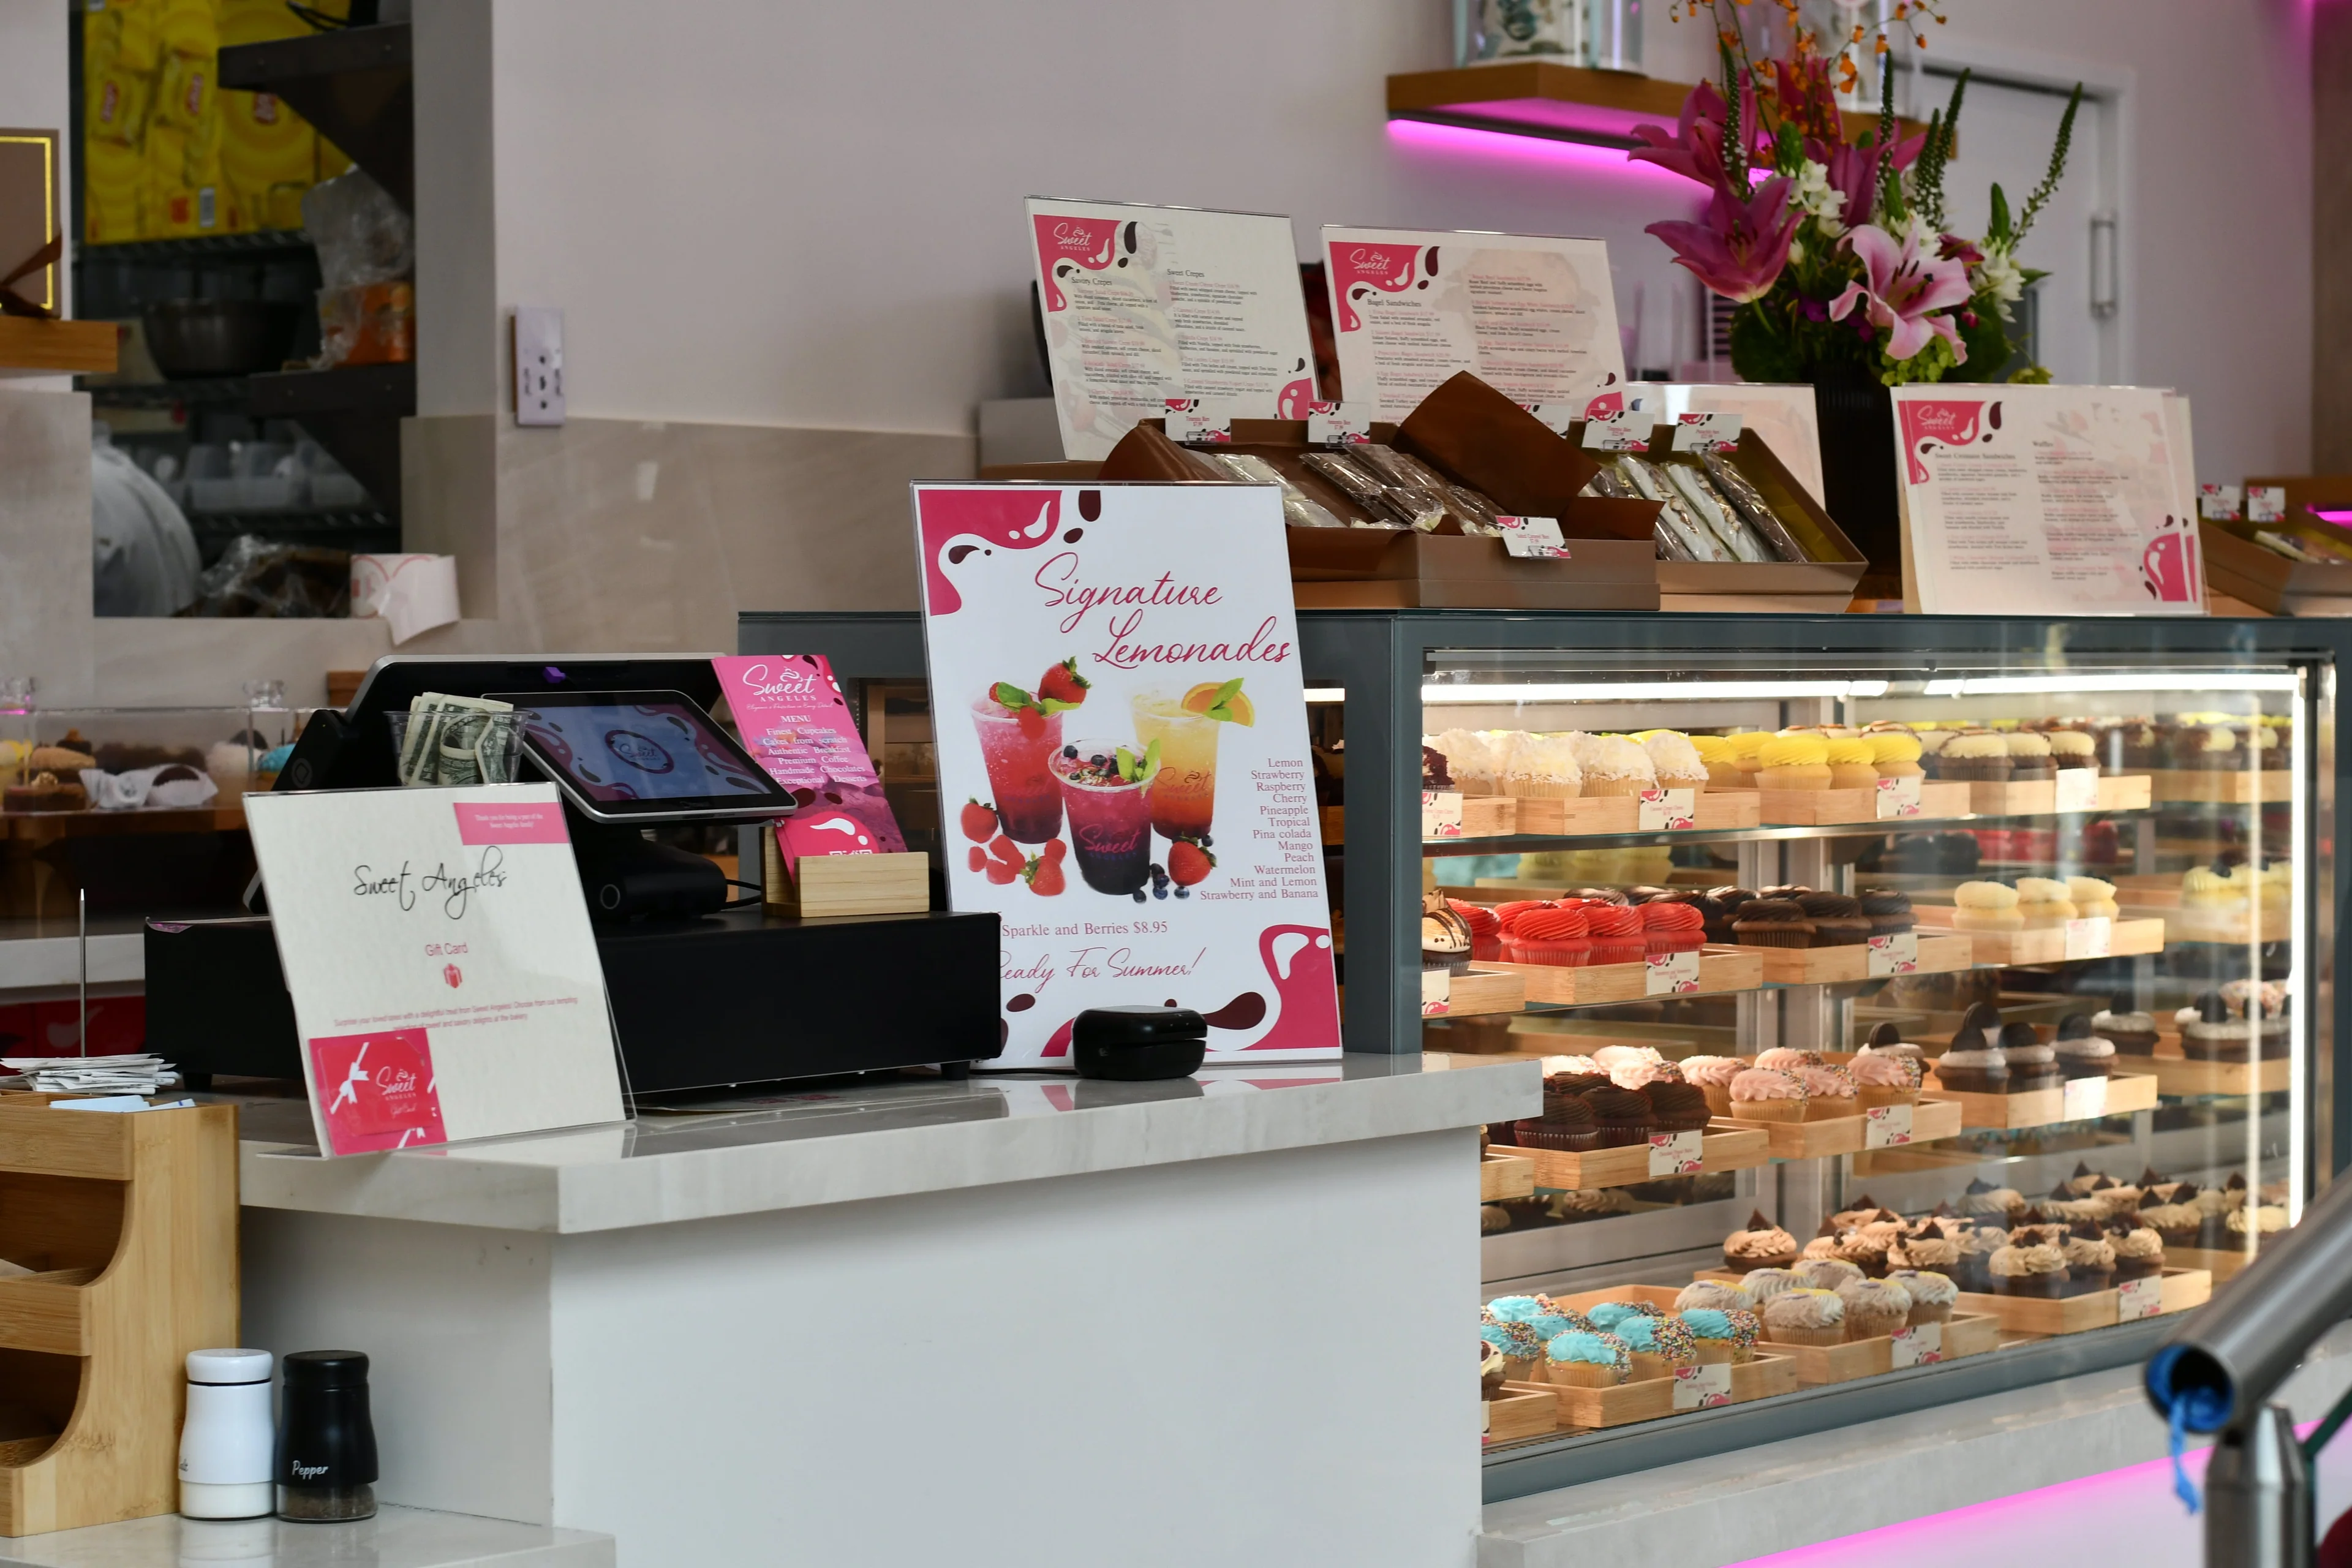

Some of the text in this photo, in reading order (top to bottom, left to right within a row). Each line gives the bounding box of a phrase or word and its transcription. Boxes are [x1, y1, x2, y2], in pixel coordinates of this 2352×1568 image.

[1054, 222, 1092, 247] Sweet
[1349, 248, 1392, 271] Sweet
[1366, 298, 1384, 307] Bagel
[1917, 405, 1956, 426] Sweet
[1034, 551, 1224, 634] Signature
[1092, 608, 1291, 669] Lemonades
[742, 663, 817, 696] Sweet
[797, 727, 837, 736] Cupcakes
[820, 755, 848, 764] Coffee
[1268, 758, 1303, 767] Lemon
[820, 765, 865, 774] Chocolates
[1251, 770, 1305, 780] Strawberry
[777, 775, 867, 786] Exceptional Desserts
[1154, 766, 1212, 793] Sweet
[1256, 782, 1306, 793] Raspberry
[1273, 793, 1308, 804] Cherry
[1260, 805, 1309, 816] Pineapple
[1268, 817, 1310, 828] Tropical
[1079, 824, 1141, 853] Sweet
[1253, 829, 1312, 839] Pina colada
[1278, 841, 1313, 852] Mango
[1284, 853, 1314, 862] Peach
[1254, 865, 1316, 875] Watermelon
[353, 845, 507, 920] Sweet Angeles
[1230, 876, 1317, 888] Mint and Lemon
[1200, 889, 1319, 901] Strawberry and Banana
[1002, 921, 1168, 939] Sparkle and Berries $8.95
[425, 941, 469, 956] Gift Card
[1066, 946, 1107, 978] For
[1107, 946, 1207, 978] Summer!
[375, 1065, 418, 1096] Sweet
[292, 1460, 329, 1480] Pepper
